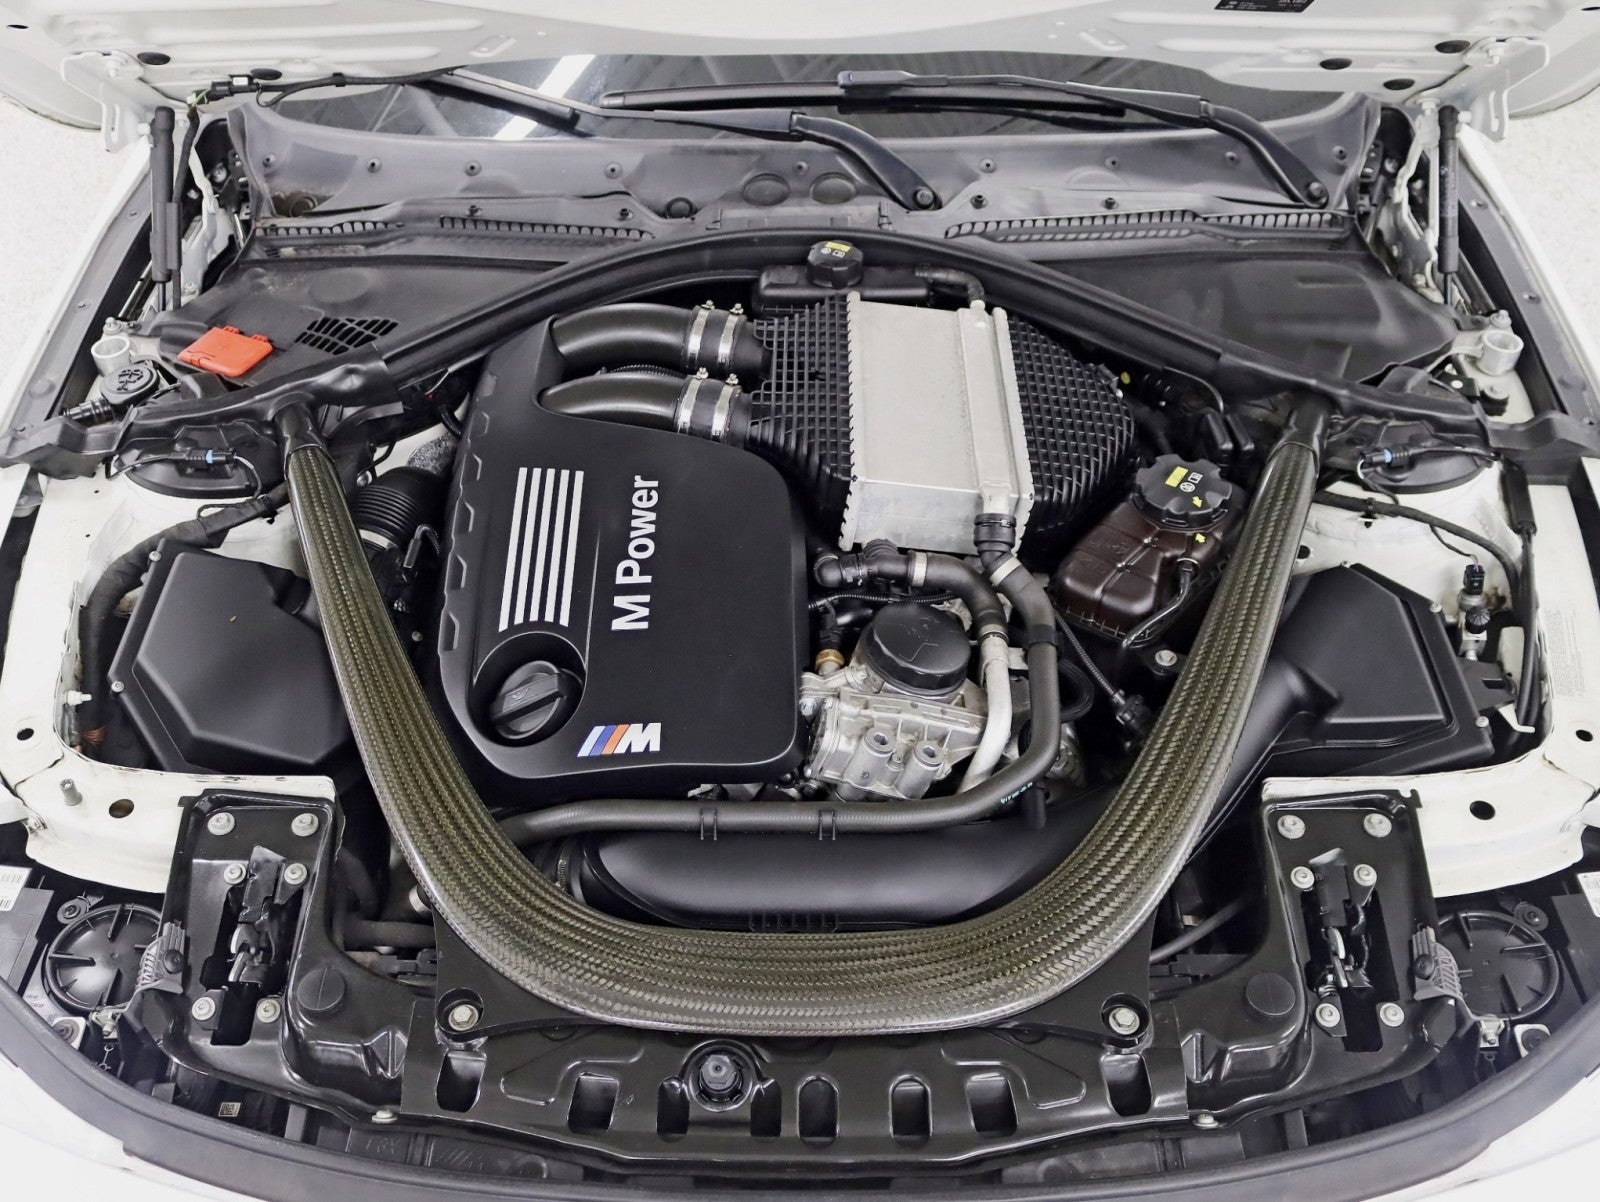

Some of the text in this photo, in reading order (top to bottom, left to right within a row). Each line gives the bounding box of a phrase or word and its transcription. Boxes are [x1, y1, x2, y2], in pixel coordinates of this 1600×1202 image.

[611, 475, 659, 630] M Power
[613, 723, 662, 754] M
